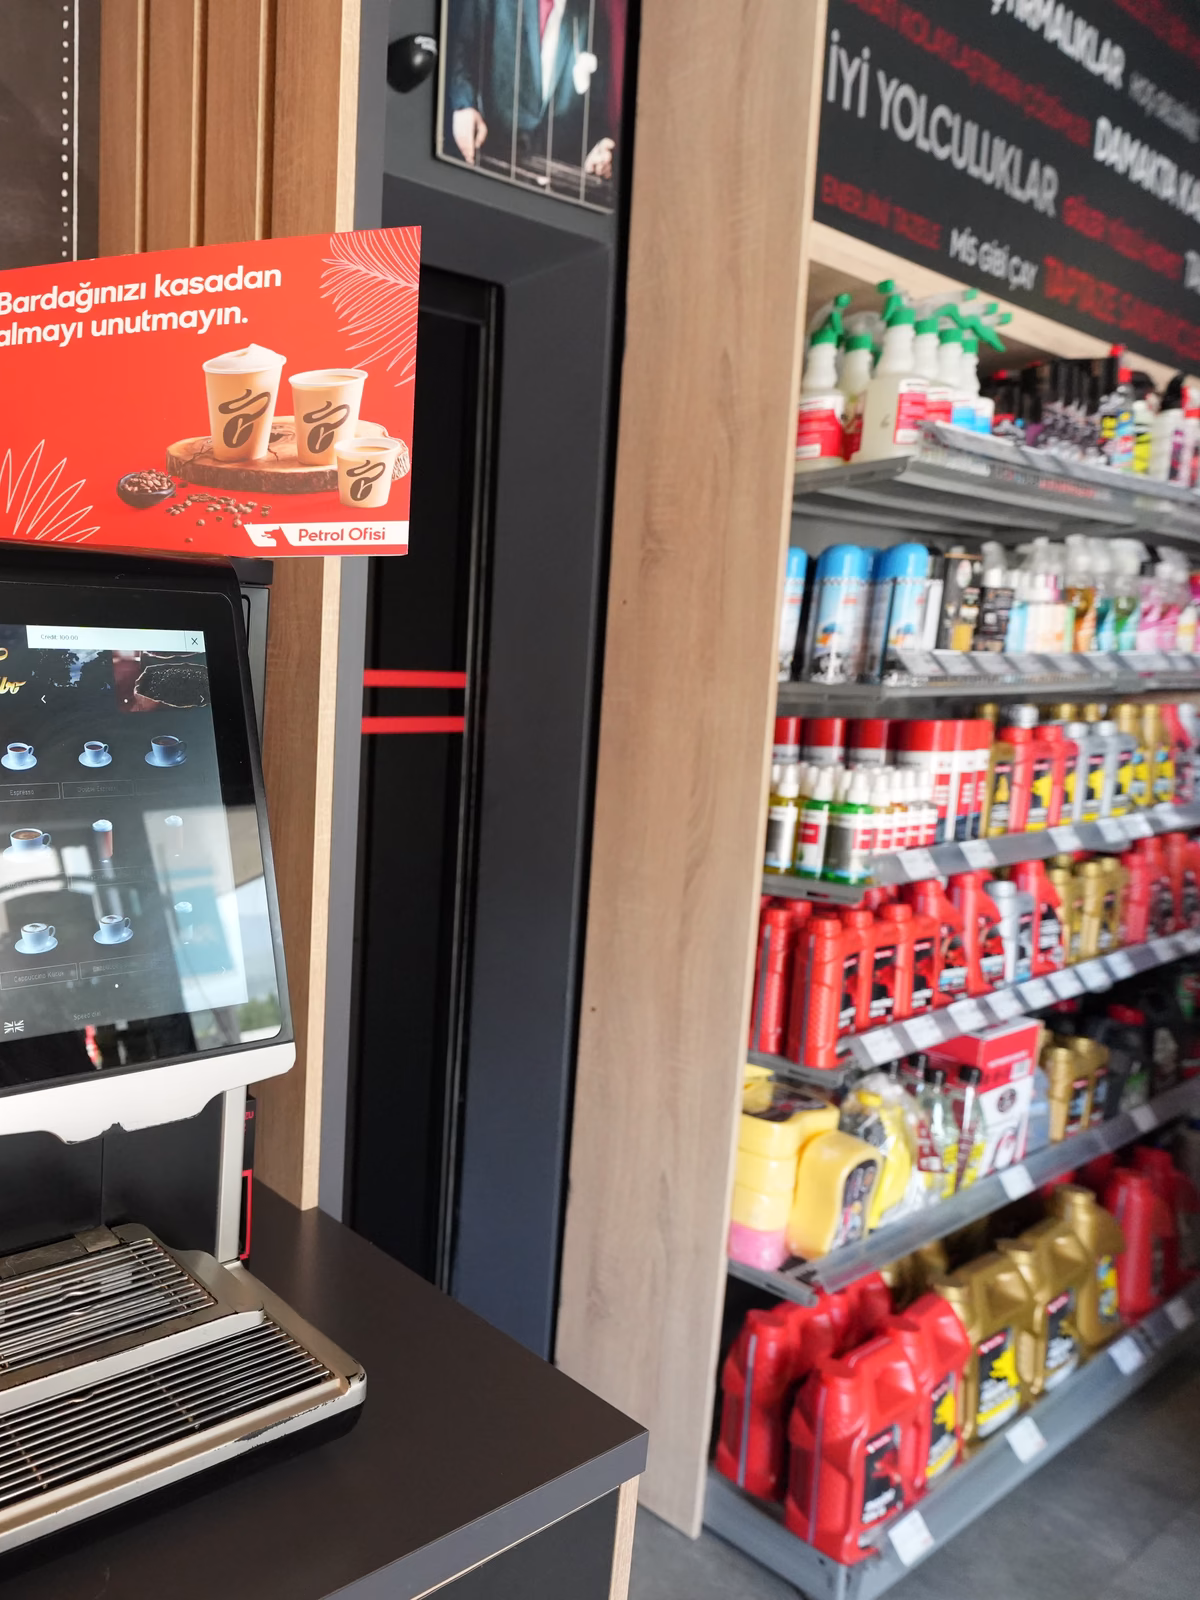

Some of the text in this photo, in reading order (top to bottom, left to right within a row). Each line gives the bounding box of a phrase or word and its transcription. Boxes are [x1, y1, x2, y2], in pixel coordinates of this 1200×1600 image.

[827, 28, 870, 119] İYİ
[877, 69, 1059, 217] YOLCULUKLAR
[154, 265, 282, 299] kasadan
[91, 302, 249, 337] unutmayın.
[298, 526, 386, 542] Petrol Ofisi
